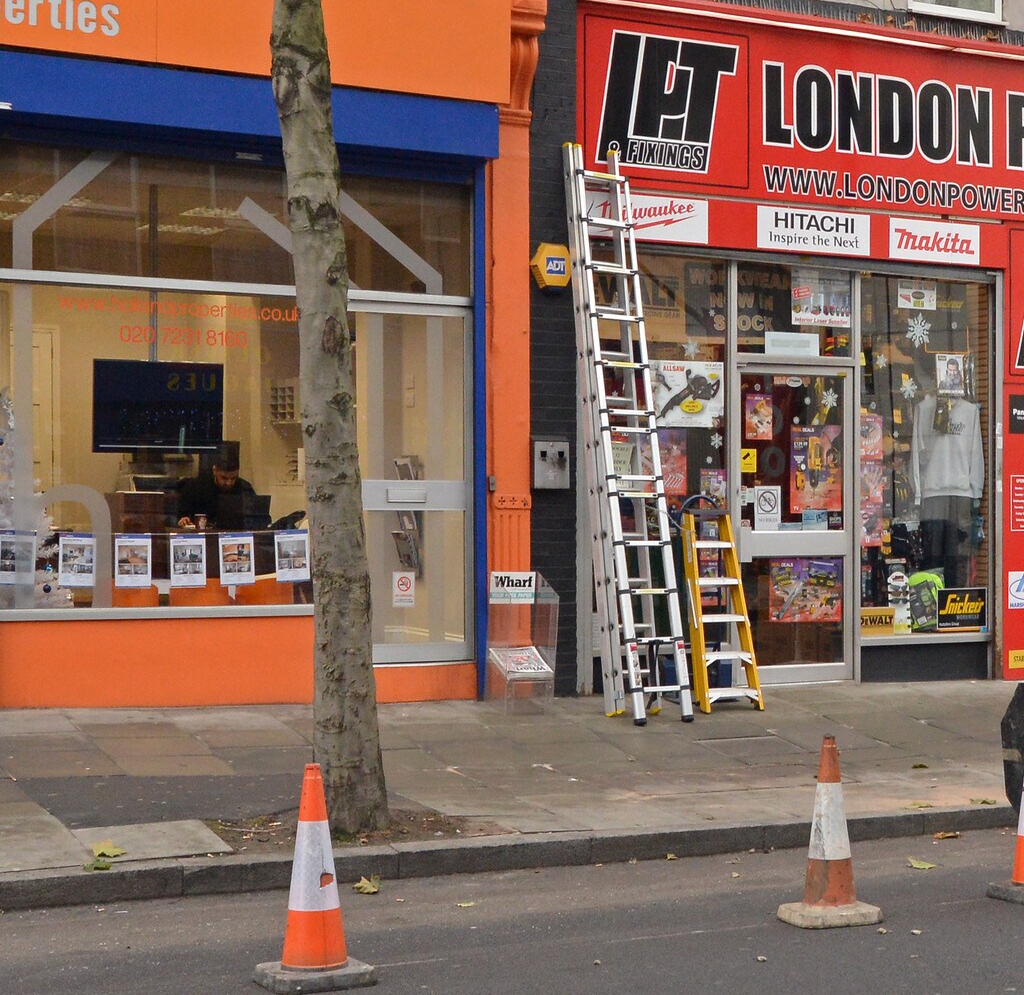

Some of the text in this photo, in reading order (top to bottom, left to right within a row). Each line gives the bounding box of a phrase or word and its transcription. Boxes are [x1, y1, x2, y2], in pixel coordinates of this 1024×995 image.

[762, 60, 993, 167] LONDON
[626, 139, 706, 171] FIXINGS
[596, 200, 695, 223] Miwaukee
[773, 211, 856, 235] HITACHI
[768, 231, 860, 250] Inspire the Next
[546, 258, 566, 275] ADT
[709, 291, 755, 309] NW
[713, 314, 774, 331] SOCK
[119, 324, 249, 349] 020 7231 8160
[494, 575, 532, 588] Wharf
[940, 594, 984, 615] Snickers
